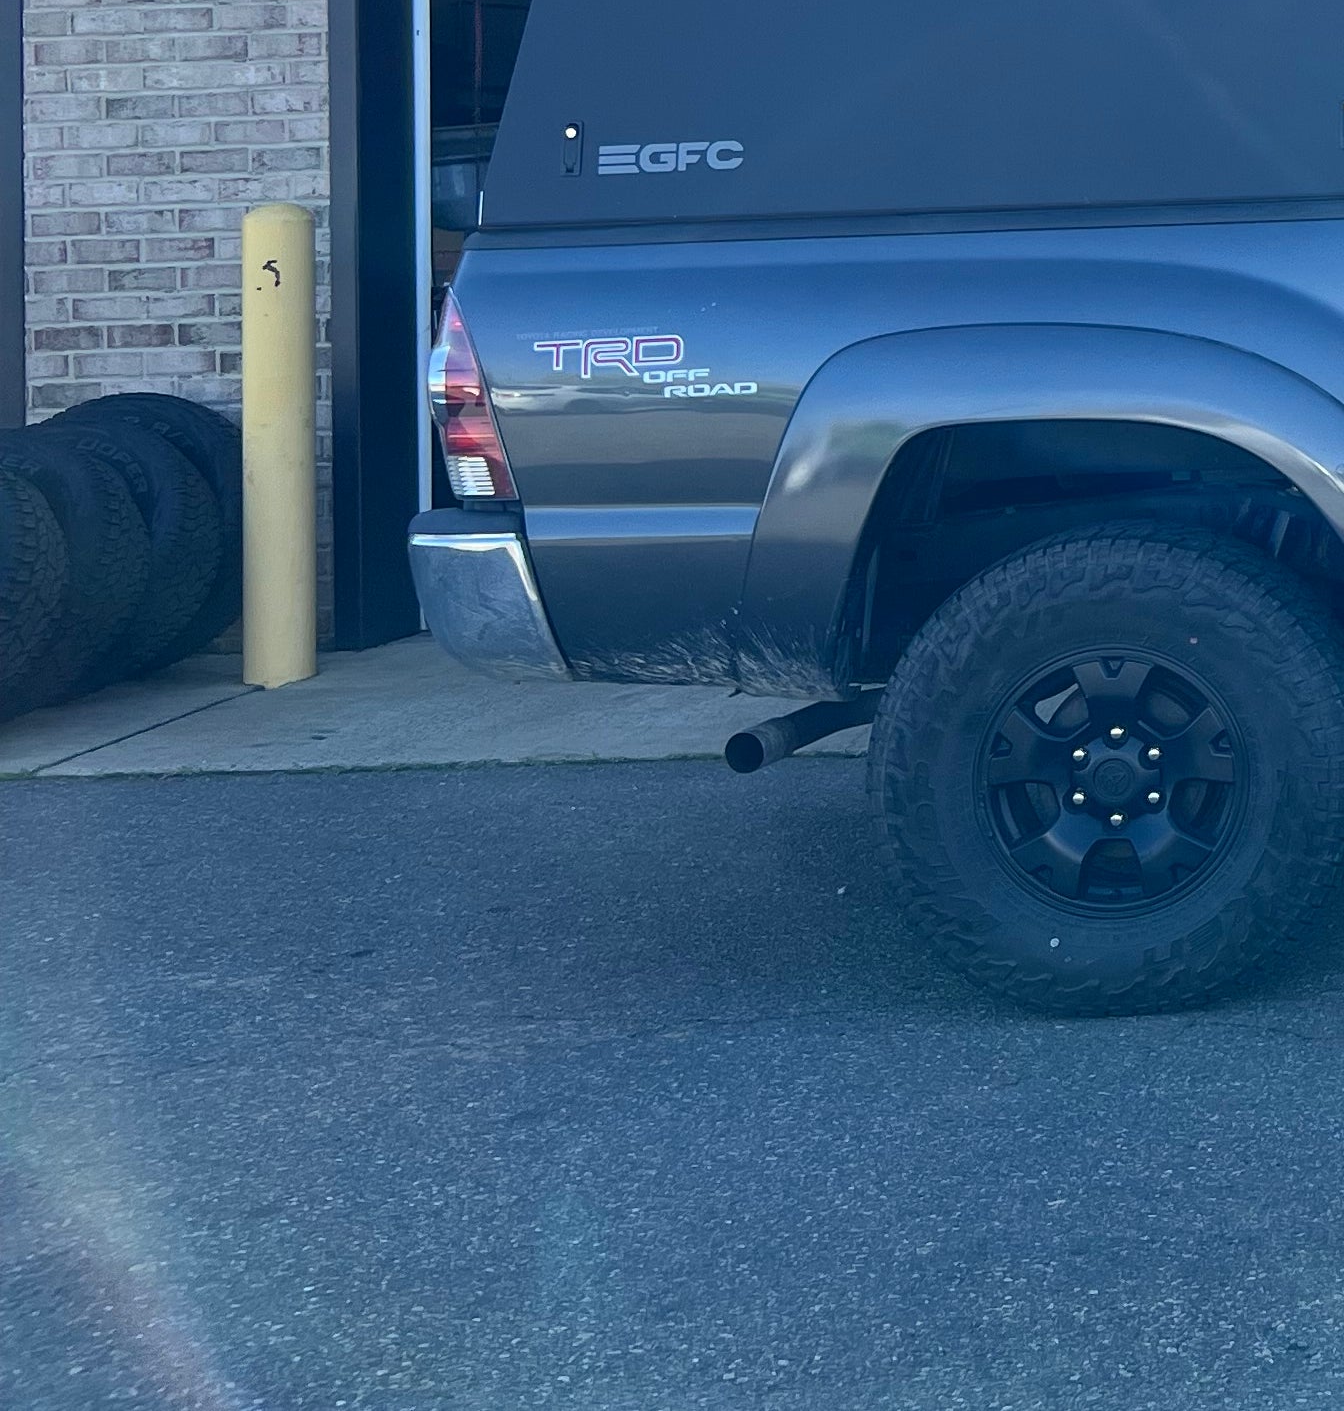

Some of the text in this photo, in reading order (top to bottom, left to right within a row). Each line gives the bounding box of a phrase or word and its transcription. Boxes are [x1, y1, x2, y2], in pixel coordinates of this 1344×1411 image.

[533, 334, 684, 379] TRD
[642, 368, 711, 383] OFF
[663, 382, 758, 398] ROAD
